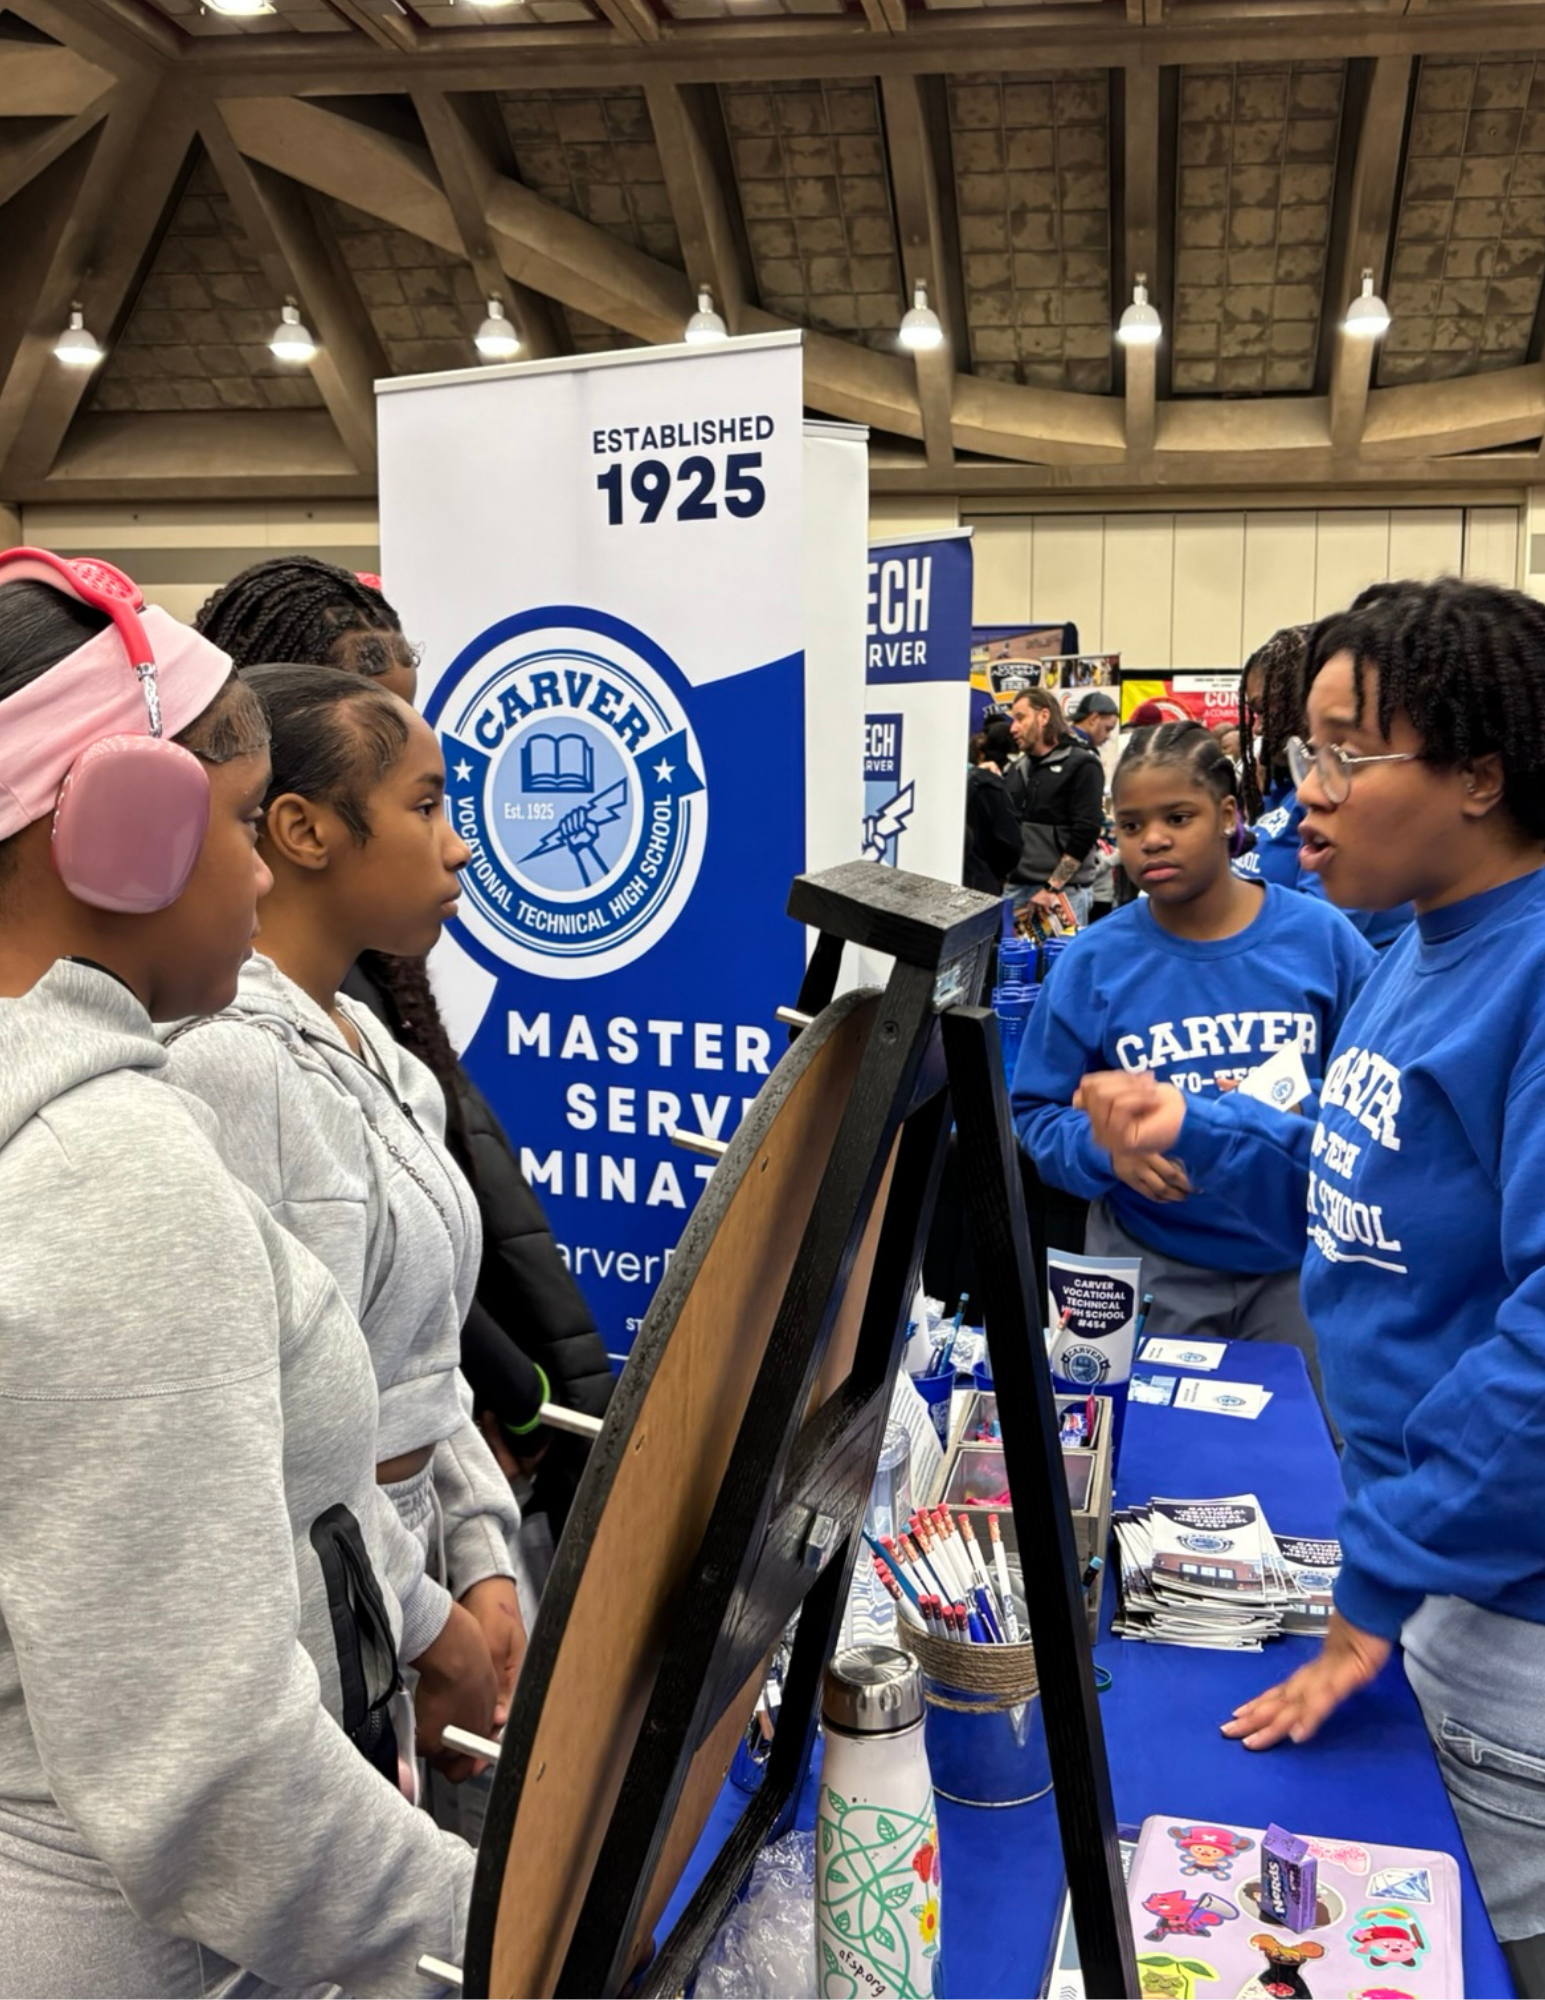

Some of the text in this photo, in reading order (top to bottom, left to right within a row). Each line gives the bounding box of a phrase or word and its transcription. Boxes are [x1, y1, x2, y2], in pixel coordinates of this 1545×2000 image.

[592, 415, 775, 455] ESTABLISHED
[597, 452, 766, 526] 1925
[475, 669, 650, 753] CARVER
[504, 803, 554, 820] Est. 1925
[458, 794, 672, 935] VOCATIONAL TECHNICAL HIGH SCHOOL
[507, 1010, 771, 1075] MASTER
[1116, 1011, 1317, 1074] CARVER
[566, 1082, 757, 1140] SERV
[1319, 1179, 1402, 1252] SCHOOL
[1062, 1286, 1126, 1300] VOCATIONAL
[1066, 1297, 1121, 1310] TECHNICAL
[1073, 1279, 1114, 1290] CARVER
[1078, 1319, 1107, 1329] #454
[1085, 1310, 1125, 1319] SCHOOL
[1069, 1347, 1102, 1362] CARVER
[838, 1949, 887, 1998] afsp.org
